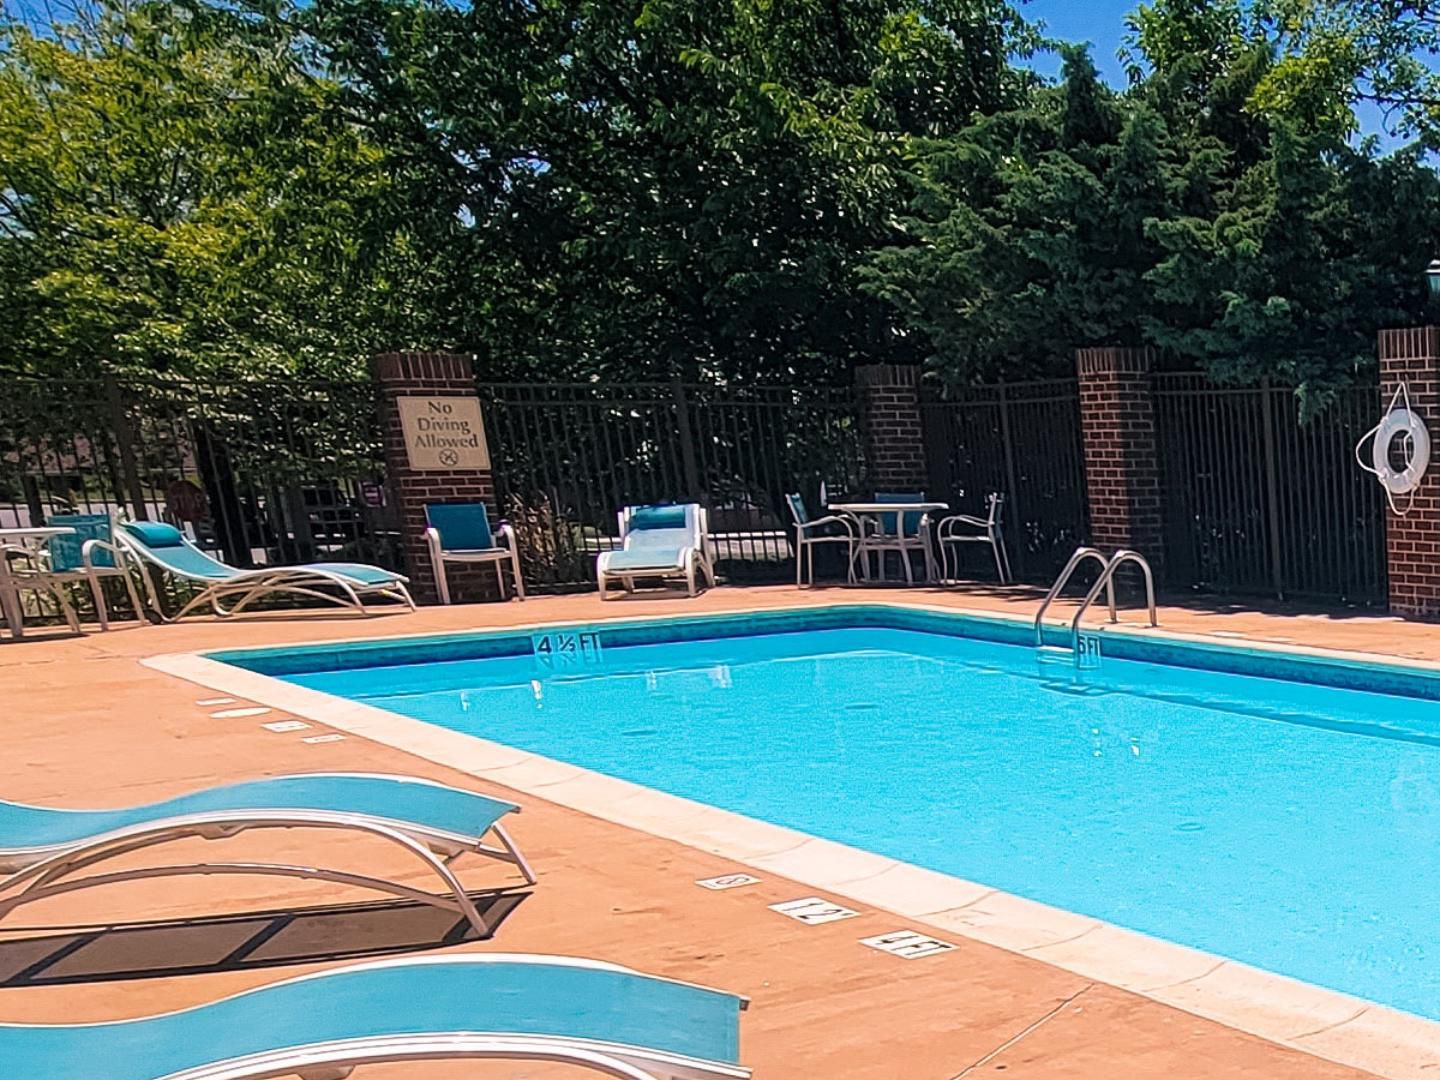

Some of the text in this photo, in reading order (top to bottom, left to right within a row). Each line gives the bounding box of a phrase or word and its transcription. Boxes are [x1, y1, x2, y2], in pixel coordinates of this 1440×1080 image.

[427, 401, 452, 415] No
[417, 416, 471, 435] Diving
[415, 433, 479, 448] Allowed
[537, 635, 552, 653] 4
[579, 632, 599, 650] FT
[1087, 637, 1099, 656] FT
